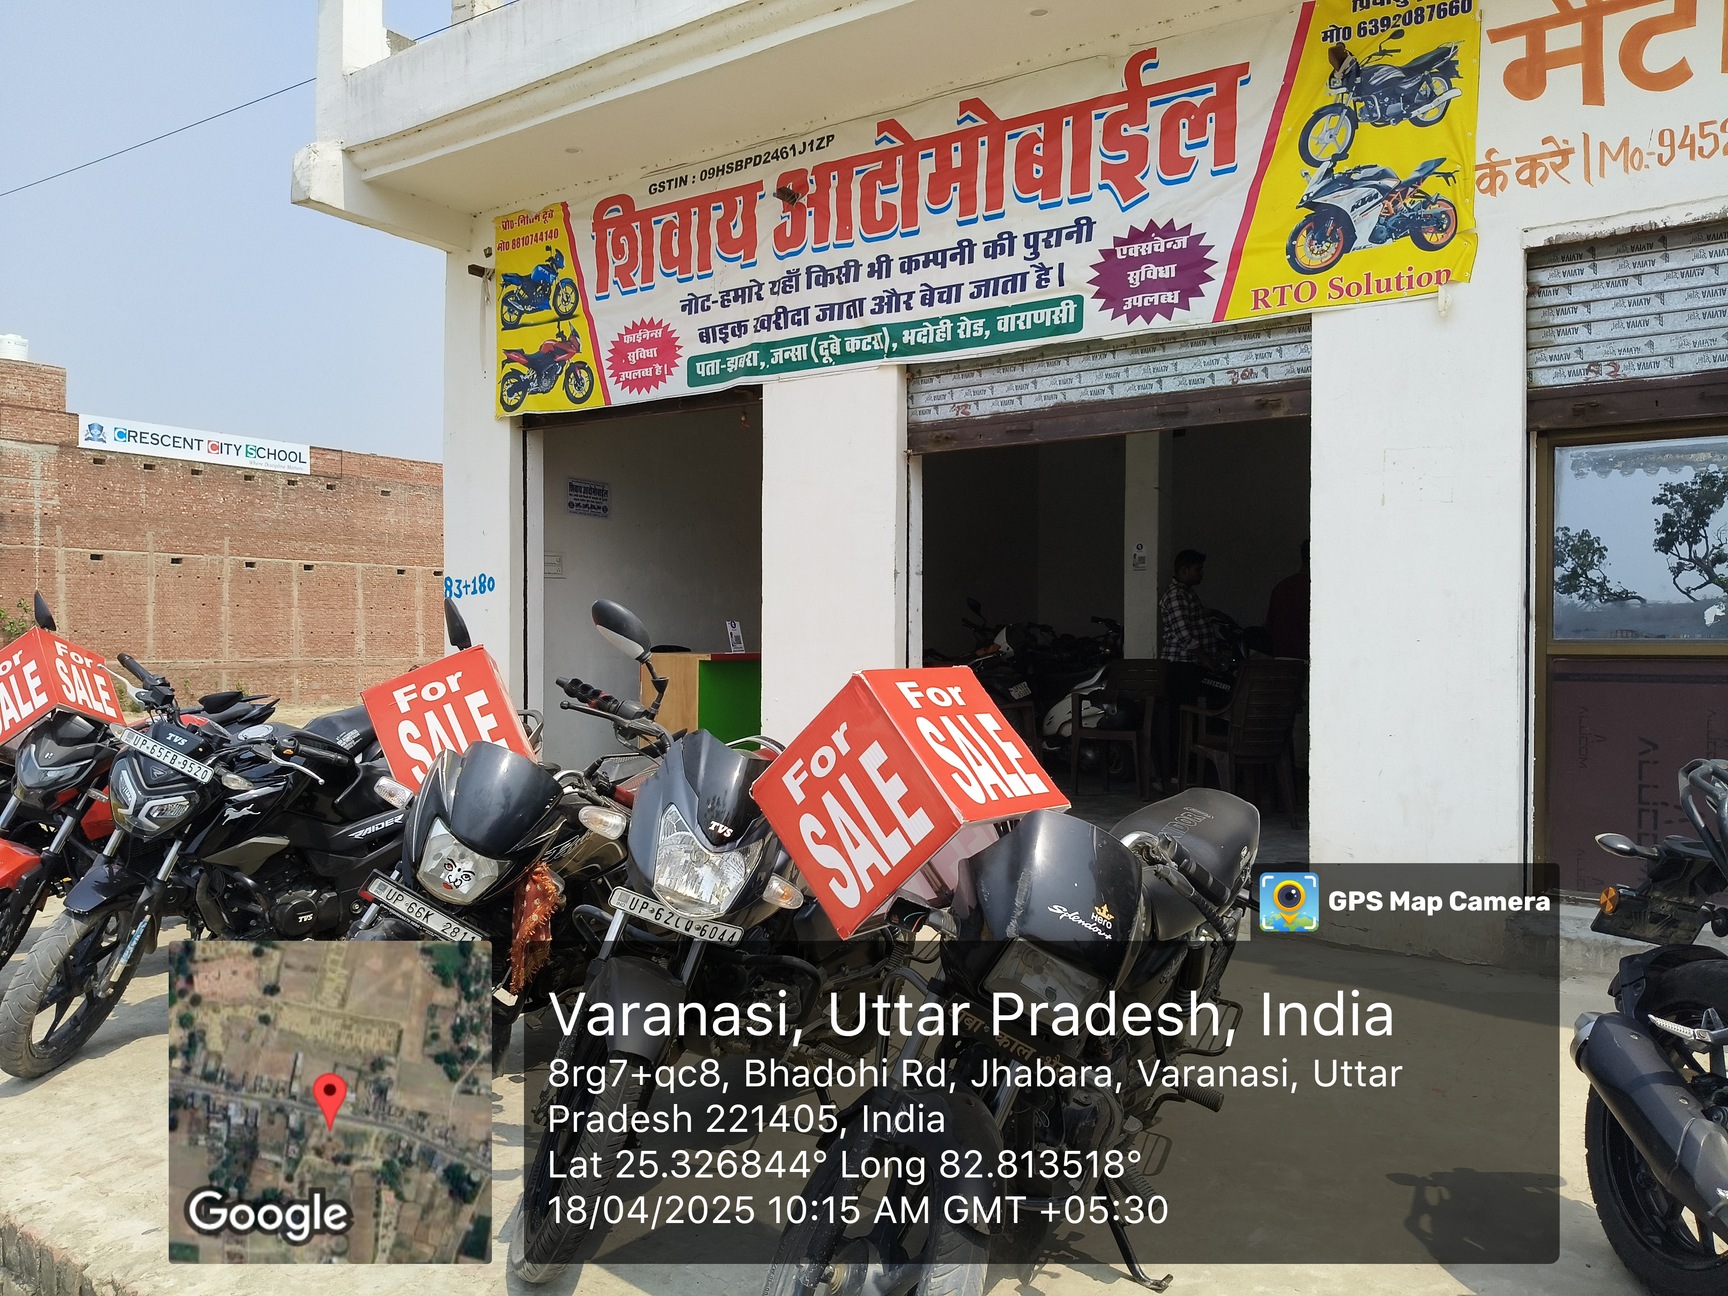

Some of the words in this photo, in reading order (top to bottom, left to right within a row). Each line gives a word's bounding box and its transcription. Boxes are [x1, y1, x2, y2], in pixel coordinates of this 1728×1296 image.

[1357, 0, 1473, 38] 6392087660
[648, 175, 688, 195] GSTIN
[699, 134, 836, 182] 09HSBPD2461J1ZP
[1515, 136, 1576, 189] करें
[511, 228, 559, 249] 8810744140
[591, 180, 766, 300] शिवाय
[680, 278, 765, 315] नोट-हमारे
[805, 259, 863, 290] किसी
[866, 254, 894, 280] भी
[898, 238, 978, 275] कम्पनी
[982, 230, 1018, 260] की
[1023, 215, 1097, 261] पुरानी
[1127, 263, 1178, 288] सुविधा
[698, 319, 750, 345] बाइक
[815, 297, 866, 322] जाता
[869, 288, 915, 315] और
[919, 282, 964, 308] बेचा
[969, 271, 1030, 300] जाता
[1122, 290, 1181, 310] उपलब्ध
[1250, 280, 1318, 311] RTO
[1327, 266, 1452, 300] Solution
[770, 342, 809, 366] जन्सा
[902, 320, 954, 346] भदोही
[957, 316, 991, 340] रोड,
[996, 299, 1078, 333] वाराणसी
[619, 367, 653, 381] उपलब्ध
[627, 347, 658, 364] सुविधा
[113, 426, 204, 452] CRESCENT
[207, 439, 243, 457] CITY
[245, 444, 307, 465] SCHOOL
[54, 640, 94, 669] For
[55, 657, 118, 719] SALE
[393, 670, 463, 714] For
[895, 681, 967, 710] For
[133, 735, 147, 749] UP
[149, 744, 178, 765] 65FB
[180, 759, 209, 780] 9520
[166, 732, 188, 746] TVS
[397, 689, 511, 787] SALE
[781, 721, 851, 806] For
[915, 713, 1051, 805] SALE
[348, 814, 404, 839] RAIDER
[709, 820, 734, 838] TVS
[799, 740, 935, 908] SALE
[298, 913, 314, 923] TVS
[385, 888, 404, 905] UP
[406, 902, 435, 924] 66K
[628, 896, 649, 914] UP
[699, 924, 737, 944] 6044
[1091, 912, 1113, 930] Hero
